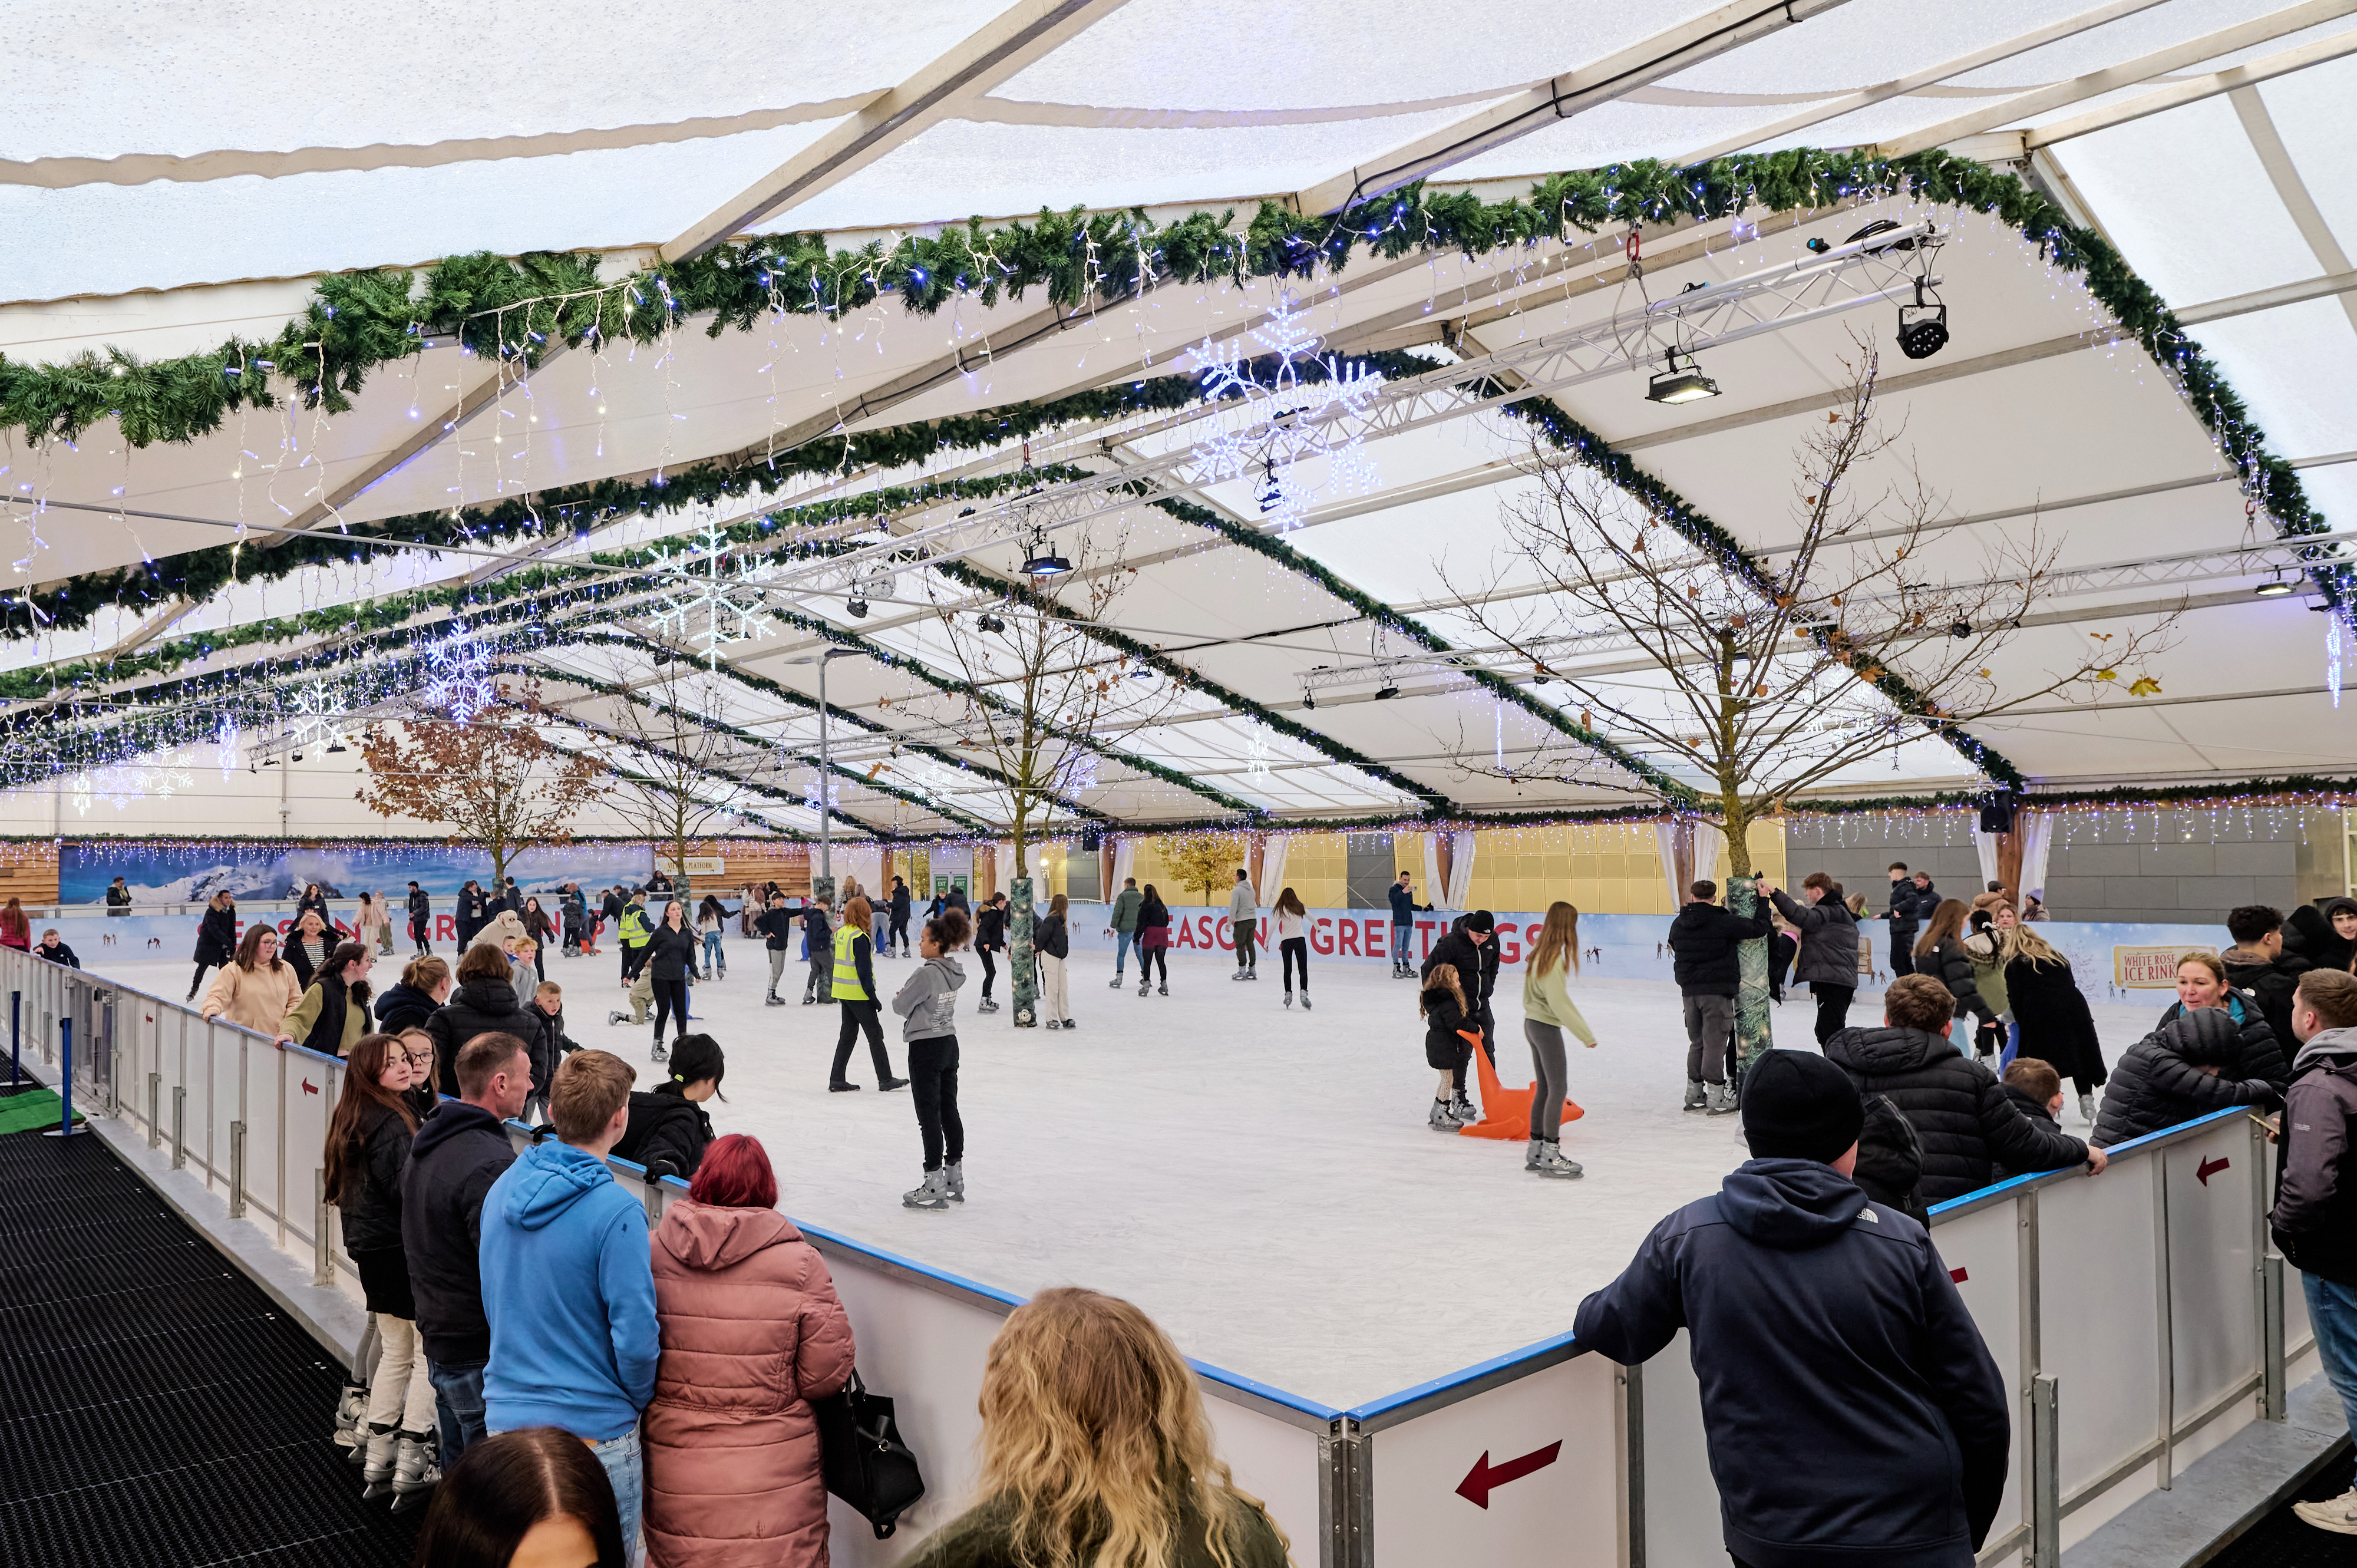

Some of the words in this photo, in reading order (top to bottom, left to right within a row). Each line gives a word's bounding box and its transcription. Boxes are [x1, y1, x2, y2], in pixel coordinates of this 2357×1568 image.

[2124, 955, 2152, 967] WHITE
[2155, 954, 2177, 965] ROSE
[2125, 967, 2144, 981] ICE
[2148, 964, 2177, 980] RINK
